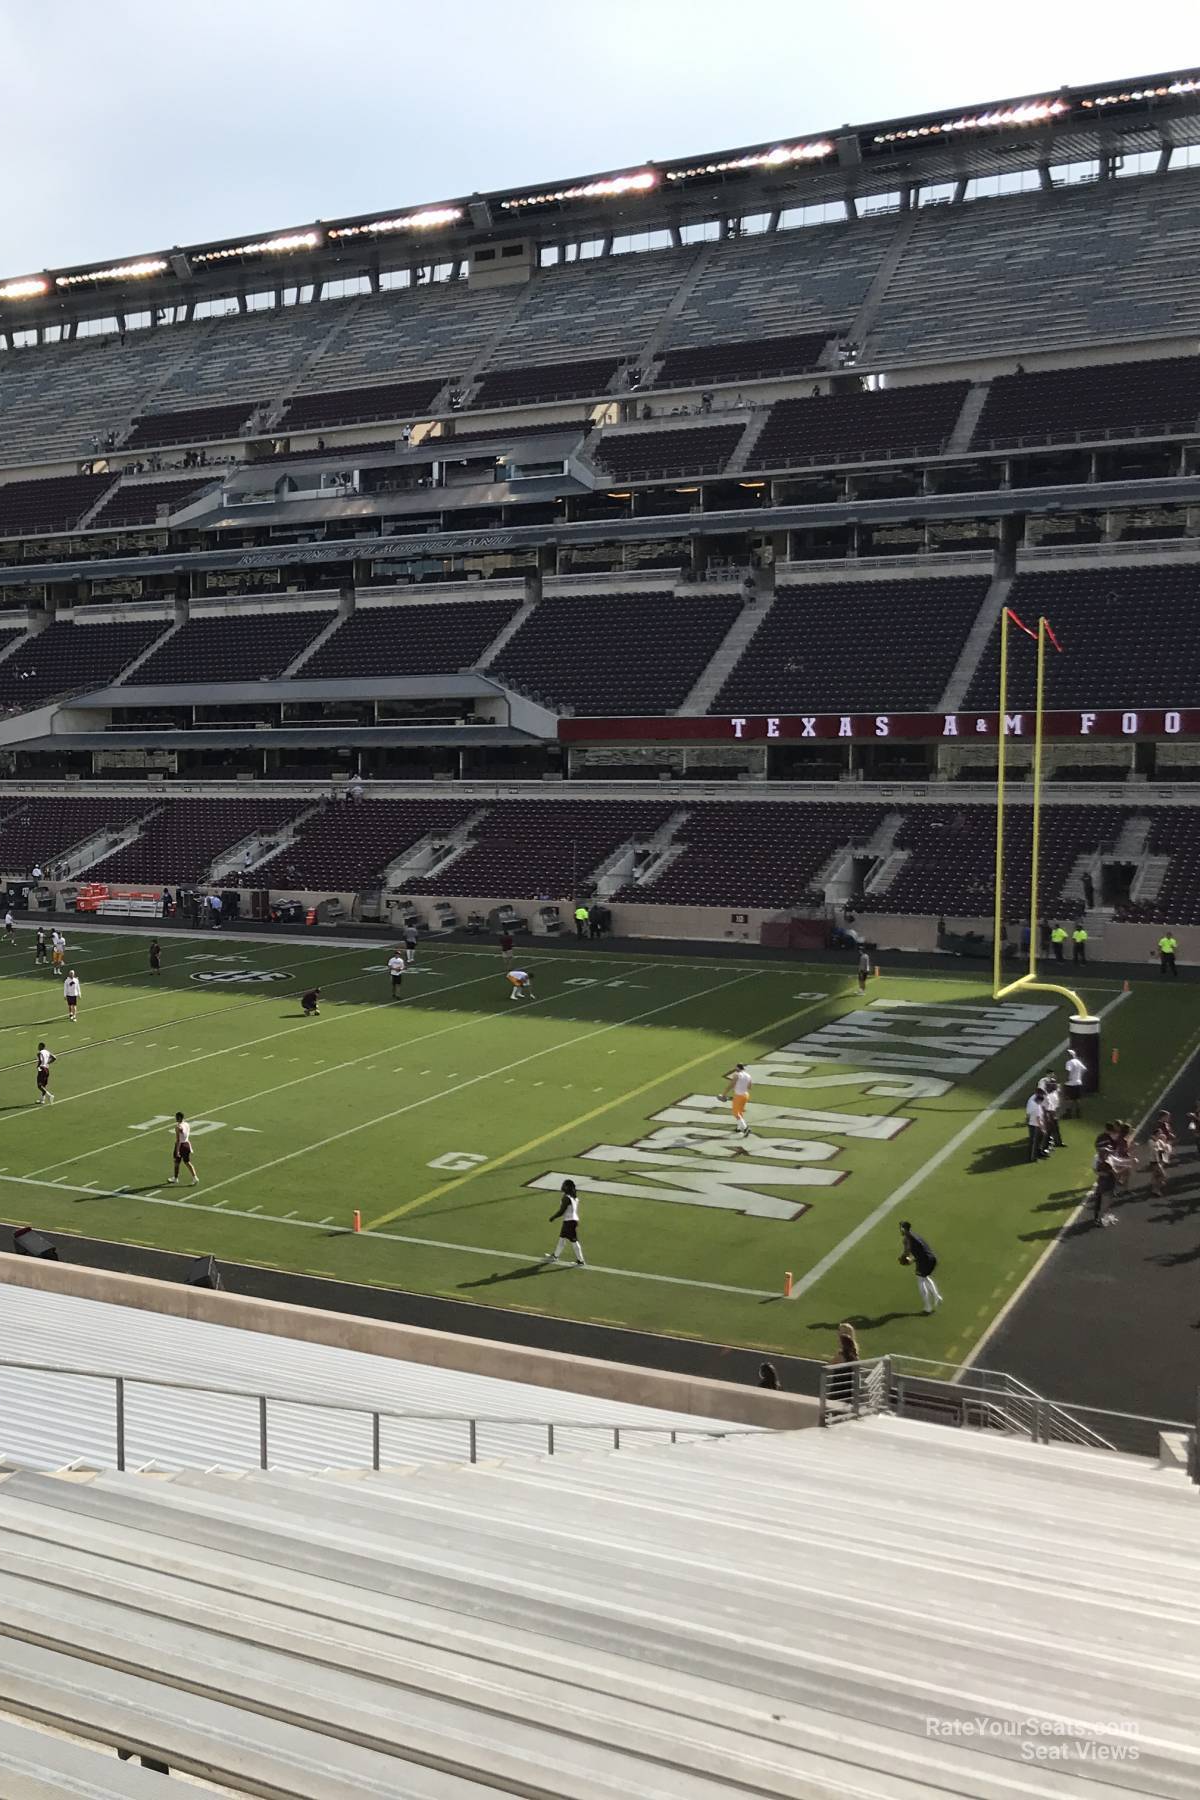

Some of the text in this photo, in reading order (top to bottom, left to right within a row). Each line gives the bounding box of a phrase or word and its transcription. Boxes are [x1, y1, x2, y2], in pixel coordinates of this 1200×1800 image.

[731, 711, 1182, 738] TEXAS A&M FOO
[522, 998, 1062, 1221] TEXAS A&M
[127, 1115, 228, 1136] 10
[426, 1152, 489, 1171] G
